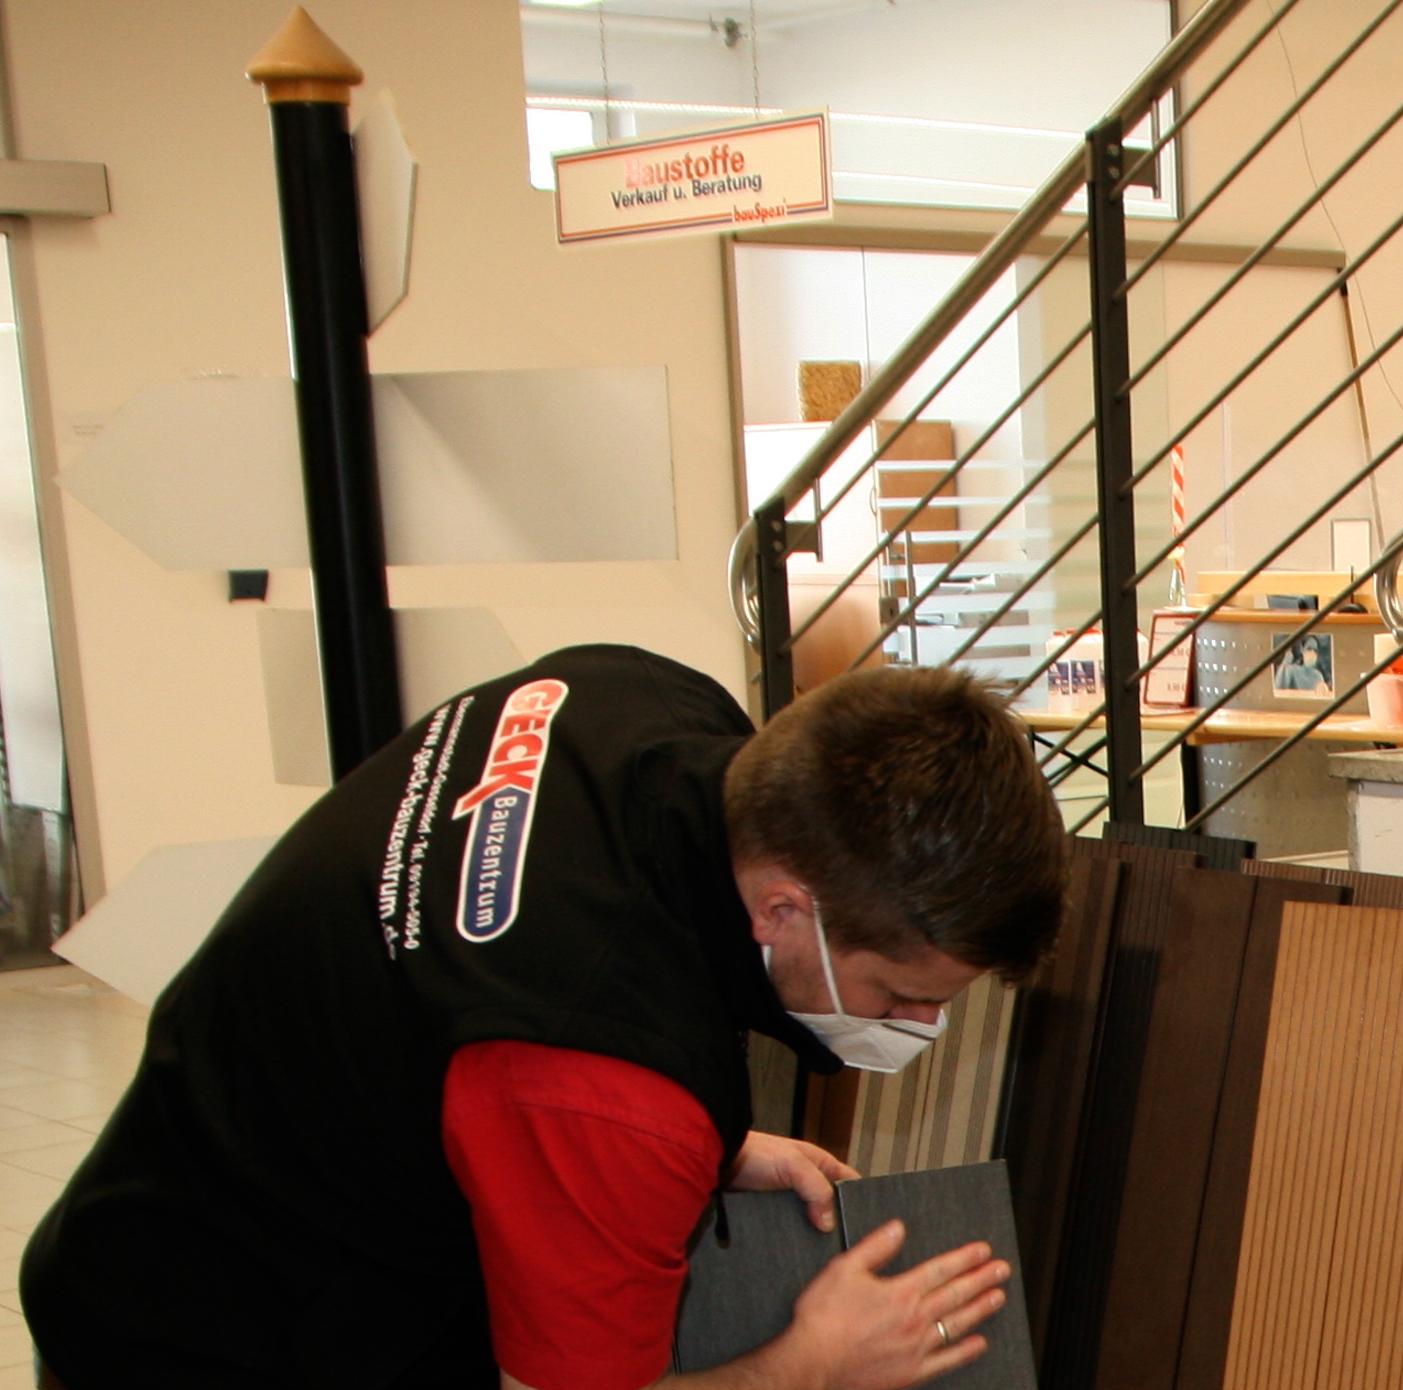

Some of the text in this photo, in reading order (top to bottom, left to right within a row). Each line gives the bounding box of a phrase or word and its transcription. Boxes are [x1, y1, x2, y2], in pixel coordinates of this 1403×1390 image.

[625, 144, 745, 188] Baustoffe
[610, 173, 763, 209] Verkauf u. Beratung
[733, 198, 787, 223] bauSpezi
[459, 681, 563, 813] GECK
[475, 795, 518, 929] Bauzentrum
